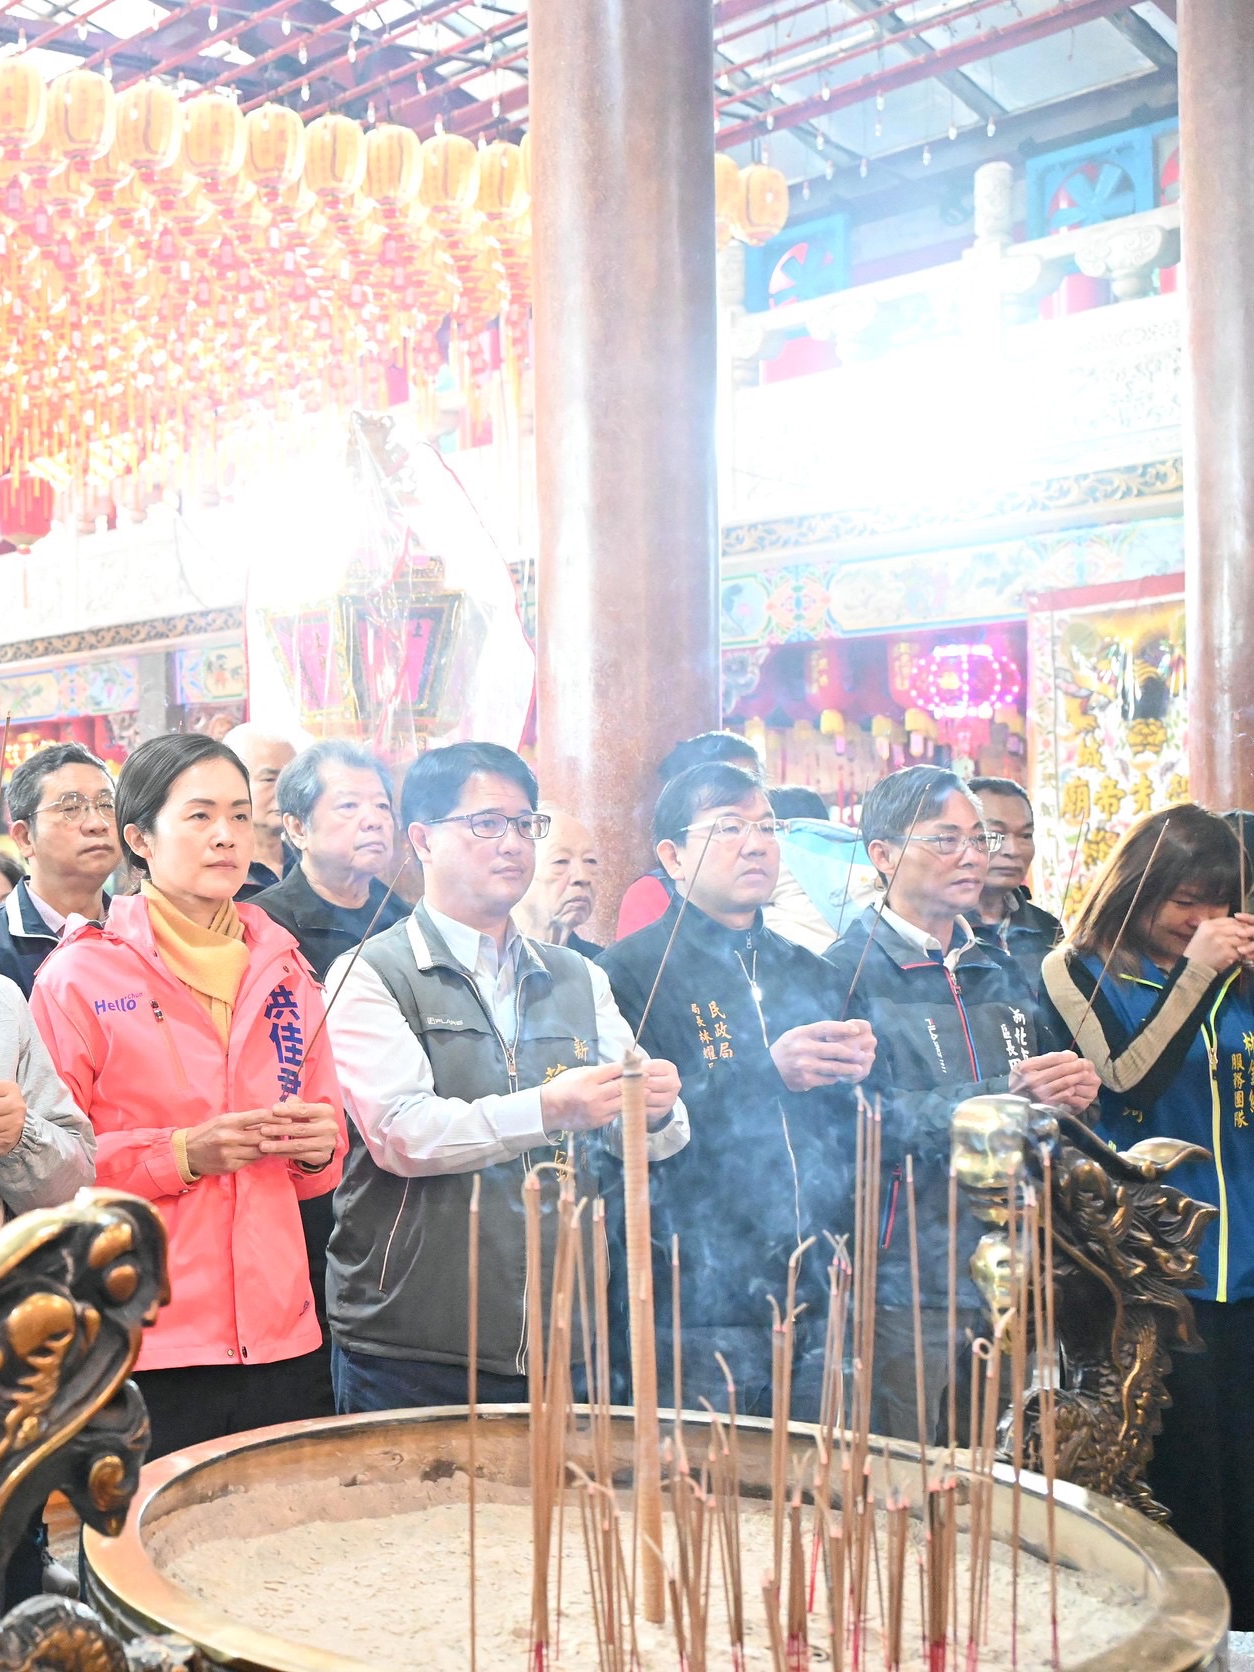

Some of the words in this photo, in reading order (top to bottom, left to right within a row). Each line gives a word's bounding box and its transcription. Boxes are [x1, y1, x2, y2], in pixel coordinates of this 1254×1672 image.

[94, 998, 137, 1016] Hello
[708, 1001, 734, 1059] 民政局
[1231, 1052, 1249, 1129] 服務團隊
